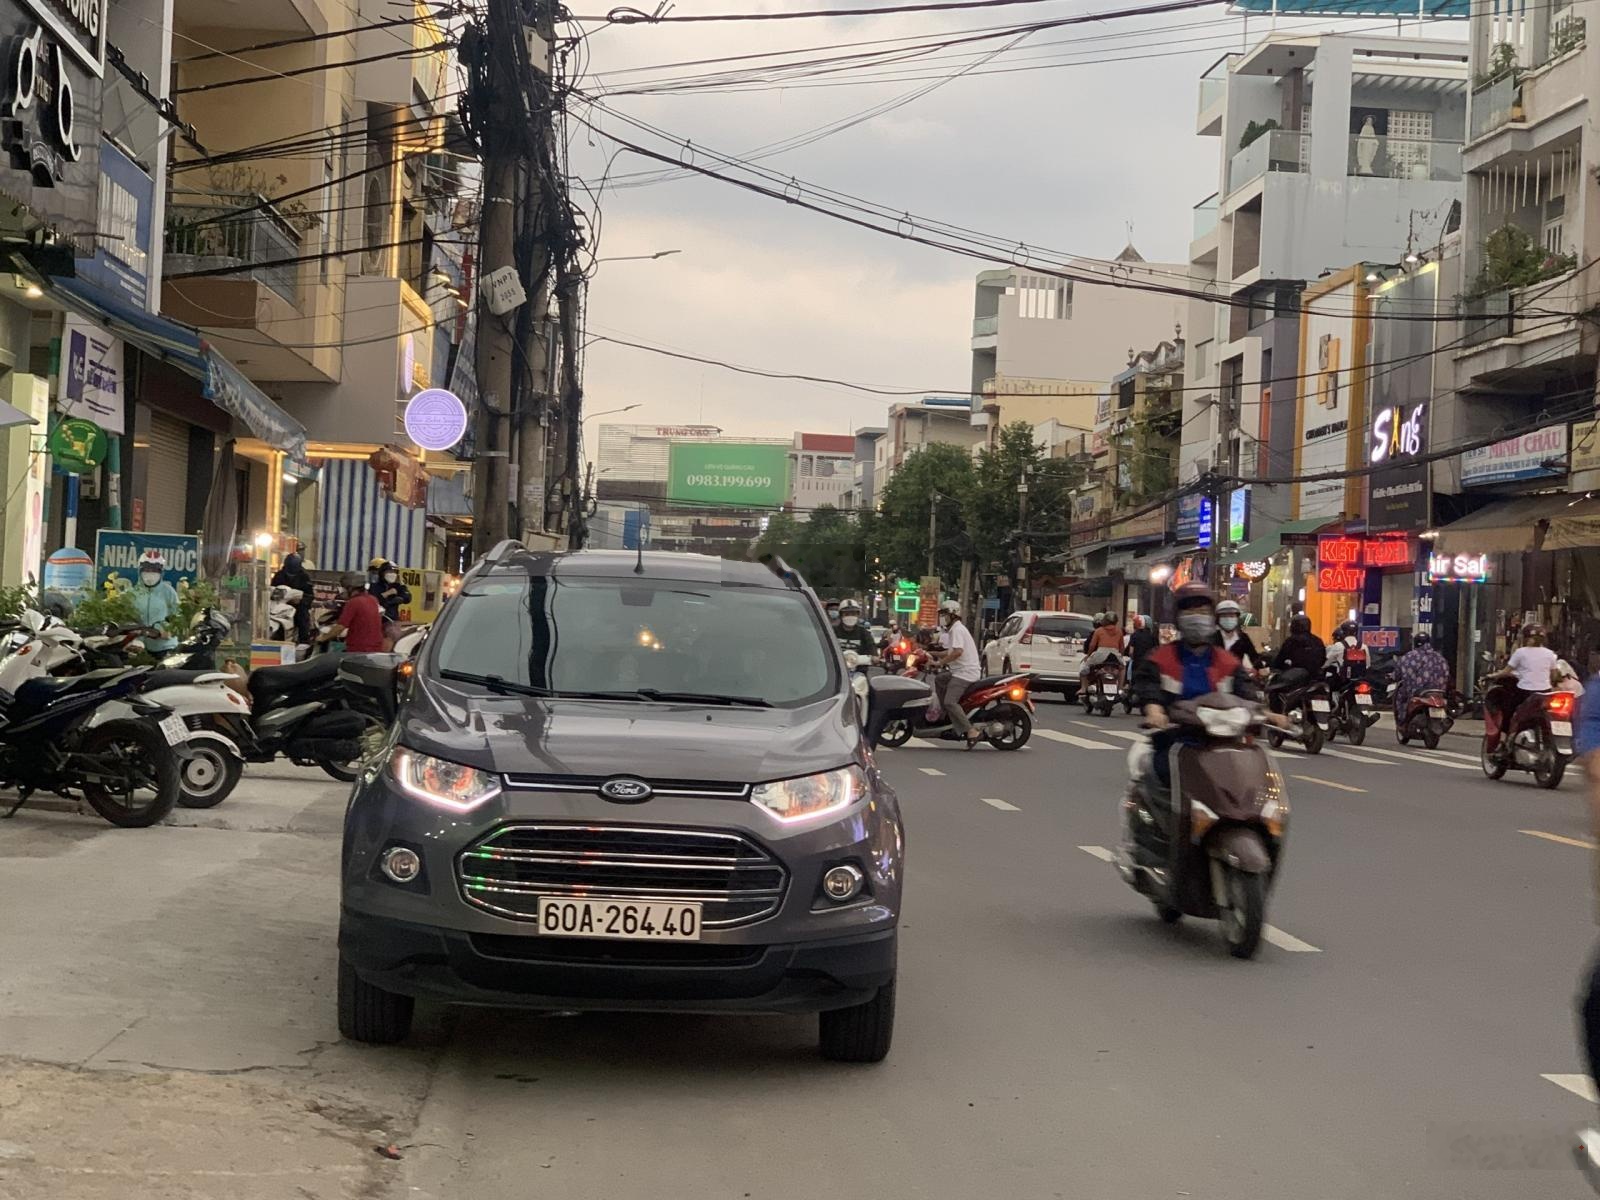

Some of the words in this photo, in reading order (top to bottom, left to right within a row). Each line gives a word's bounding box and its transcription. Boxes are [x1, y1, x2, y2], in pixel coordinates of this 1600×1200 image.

[687, 474, 771, 488] 0983.199.699
[103, 541, 138, 568] NHÀ
[143, 541, 197, 572] UỐC
[1320, 536, 1360, 562] KÉT
[1361, 627, 1398, 648] KÉT
[611, 782, 640, 795] Ford
[545, 903, 695, 936] 60A-264.40
